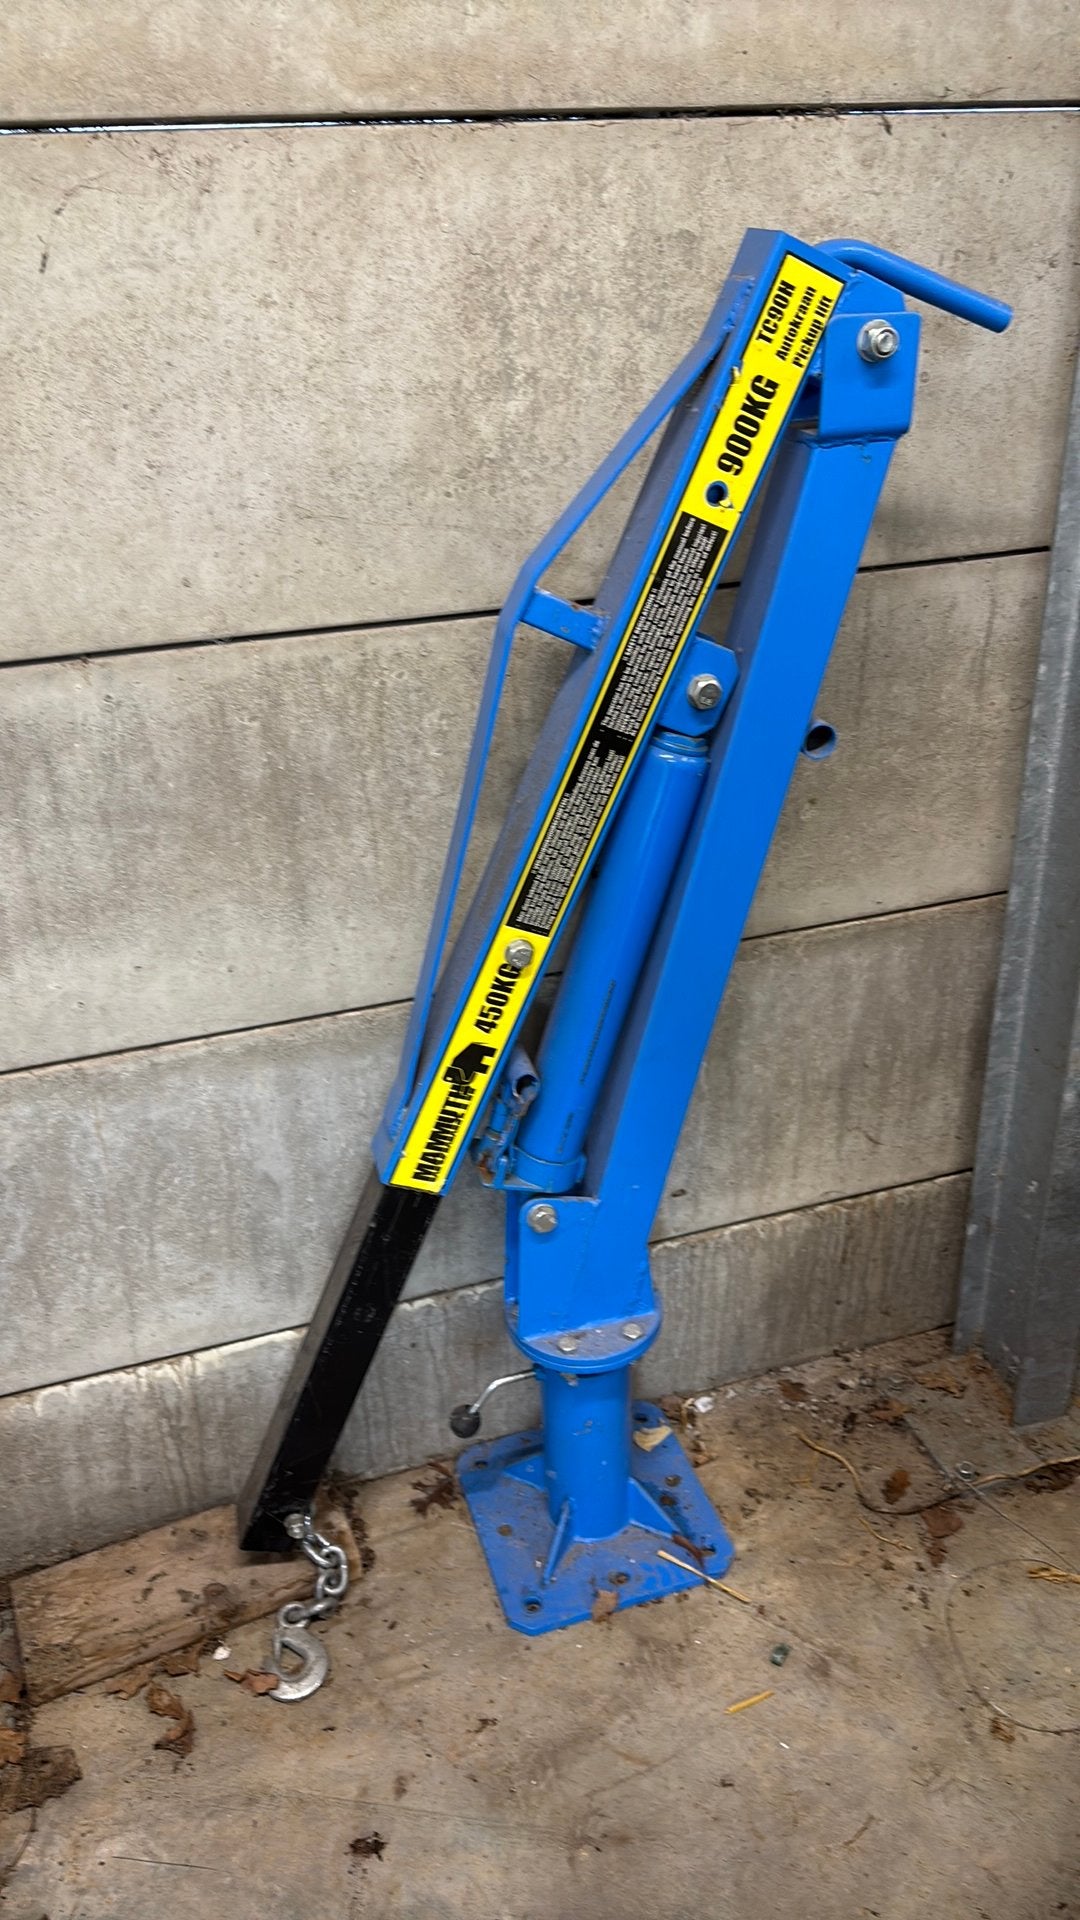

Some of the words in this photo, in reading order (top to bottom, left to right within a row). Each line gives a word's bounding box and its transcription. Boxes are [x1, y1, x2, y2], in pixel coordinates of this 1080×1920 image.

[756, 279, 797, 344] TC90H
[774, 286, 817, 362] Autokraan
[791, 318, 825, 369] Pickup
[815, 294, 833, 319] lift
[717, 374, 780, 476] 900KG
[473, 963, 523, 1034] 450KG
[412, 1084, 477, 1183] MAMMUTH
